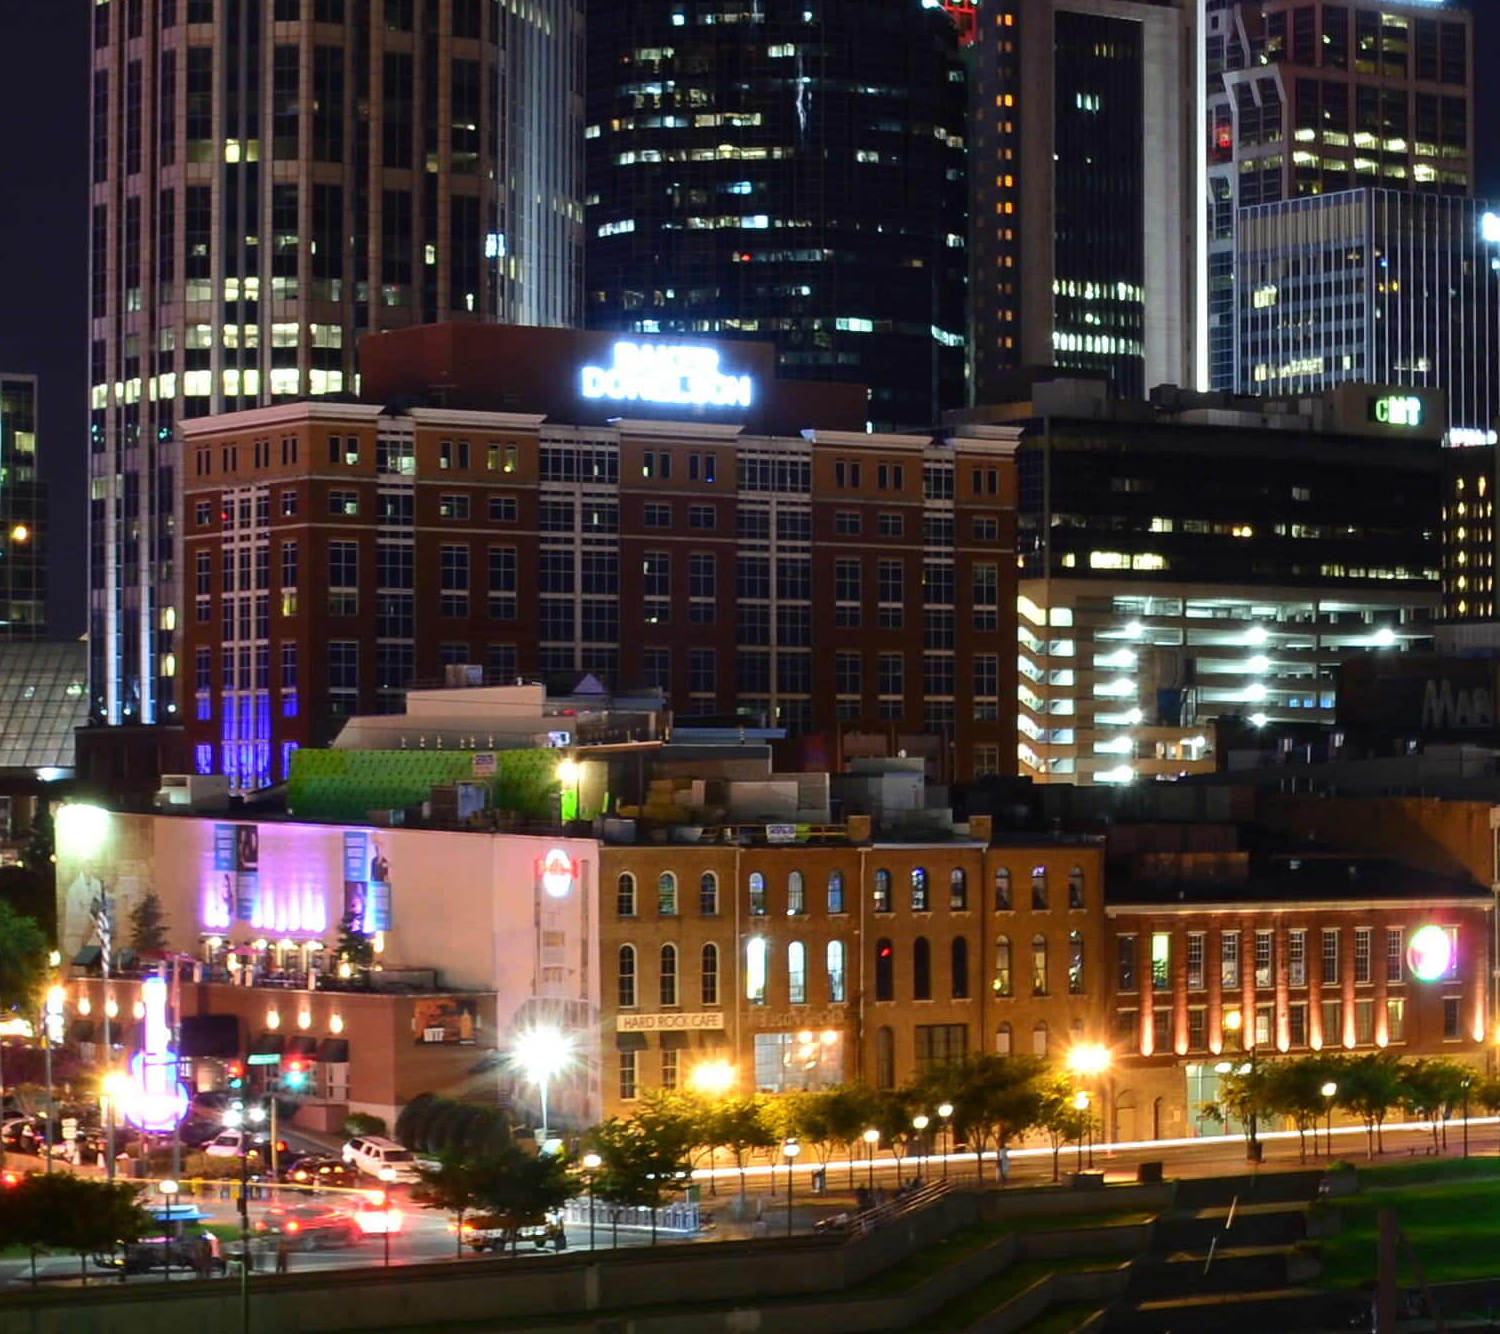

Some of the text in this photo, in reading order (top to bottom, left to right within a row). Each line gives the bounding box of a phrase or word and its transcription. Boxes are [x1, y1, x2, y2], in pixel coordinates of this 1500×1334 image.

[1375, 396, 1421, 426] CMT
[623, 1014, 719, 1029] HARD ROCK CAFE
